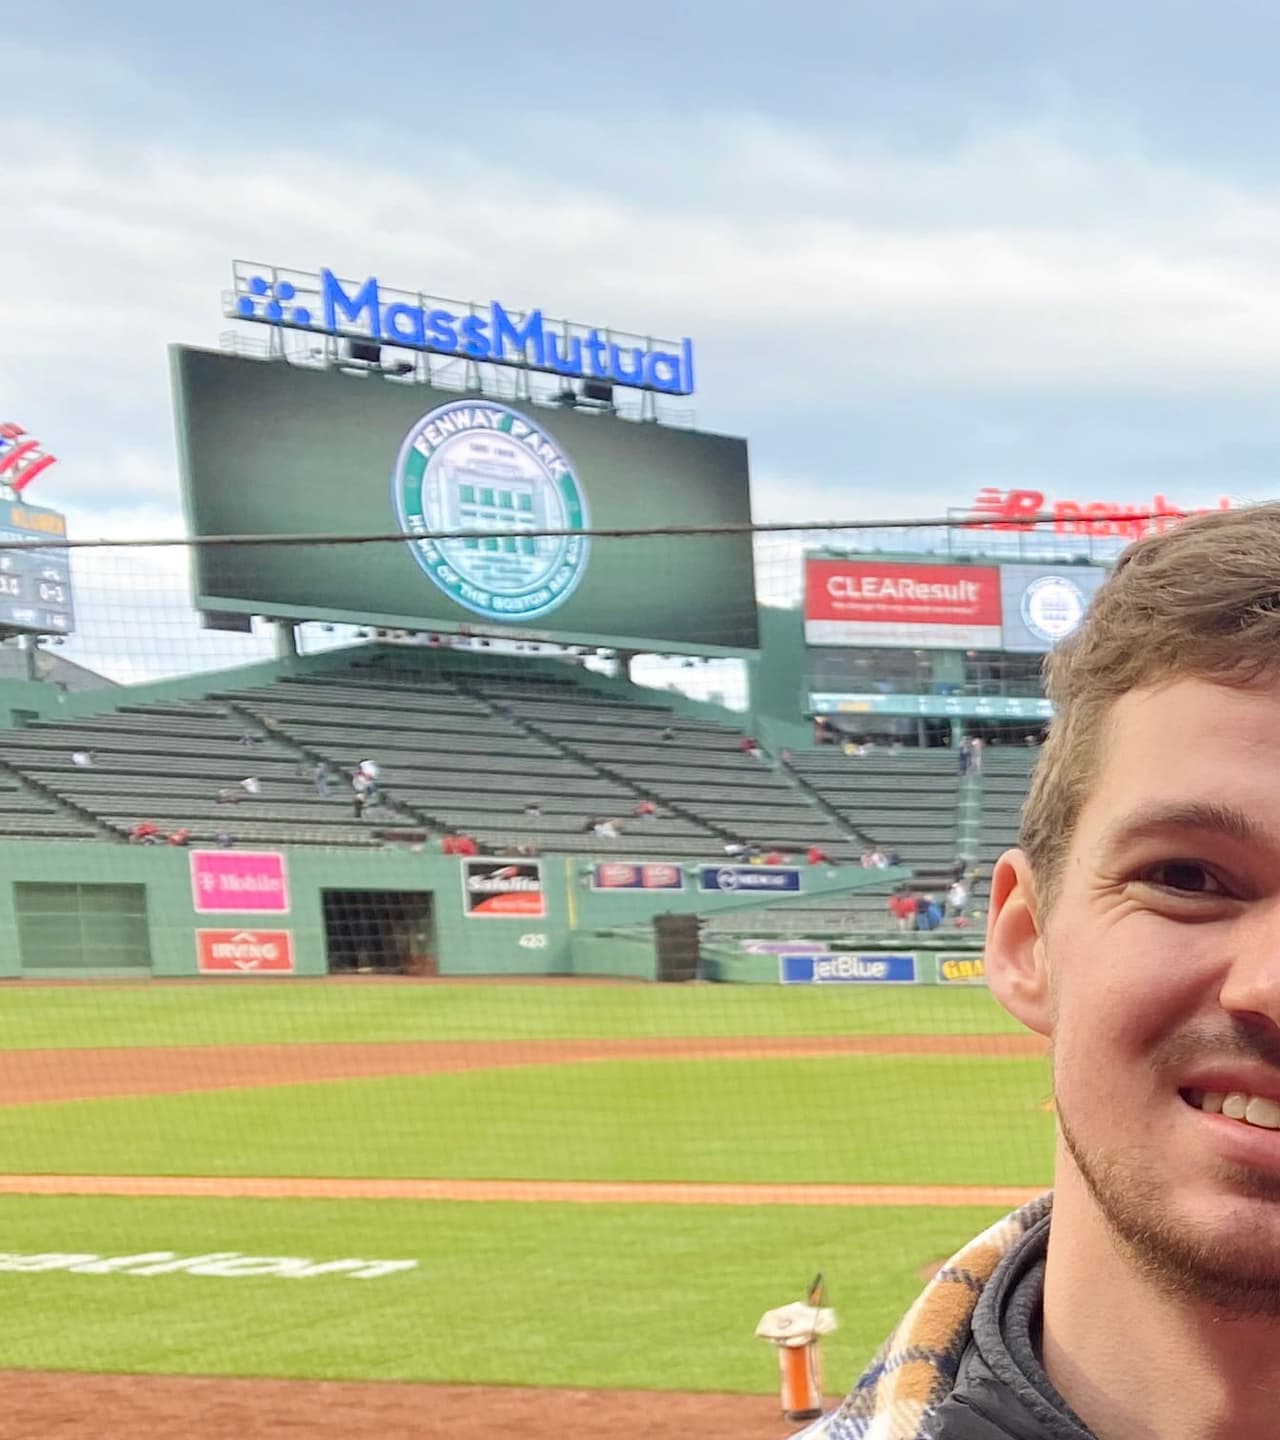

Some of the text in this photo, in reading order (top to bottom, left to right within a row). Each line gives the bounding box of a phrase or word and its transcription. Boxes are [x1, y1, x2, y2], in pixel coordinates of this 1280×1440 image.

[319, 267, 695, 396] MassMutual
[413, 407, 570, 474] FENWAY PARK
[826, 575, 981, 603] CLEAResult
[219, 872, 281, 892] Mobile
[211, 942, 279, 960] IRVING
[812, 956, 889, 981] jetBlue
